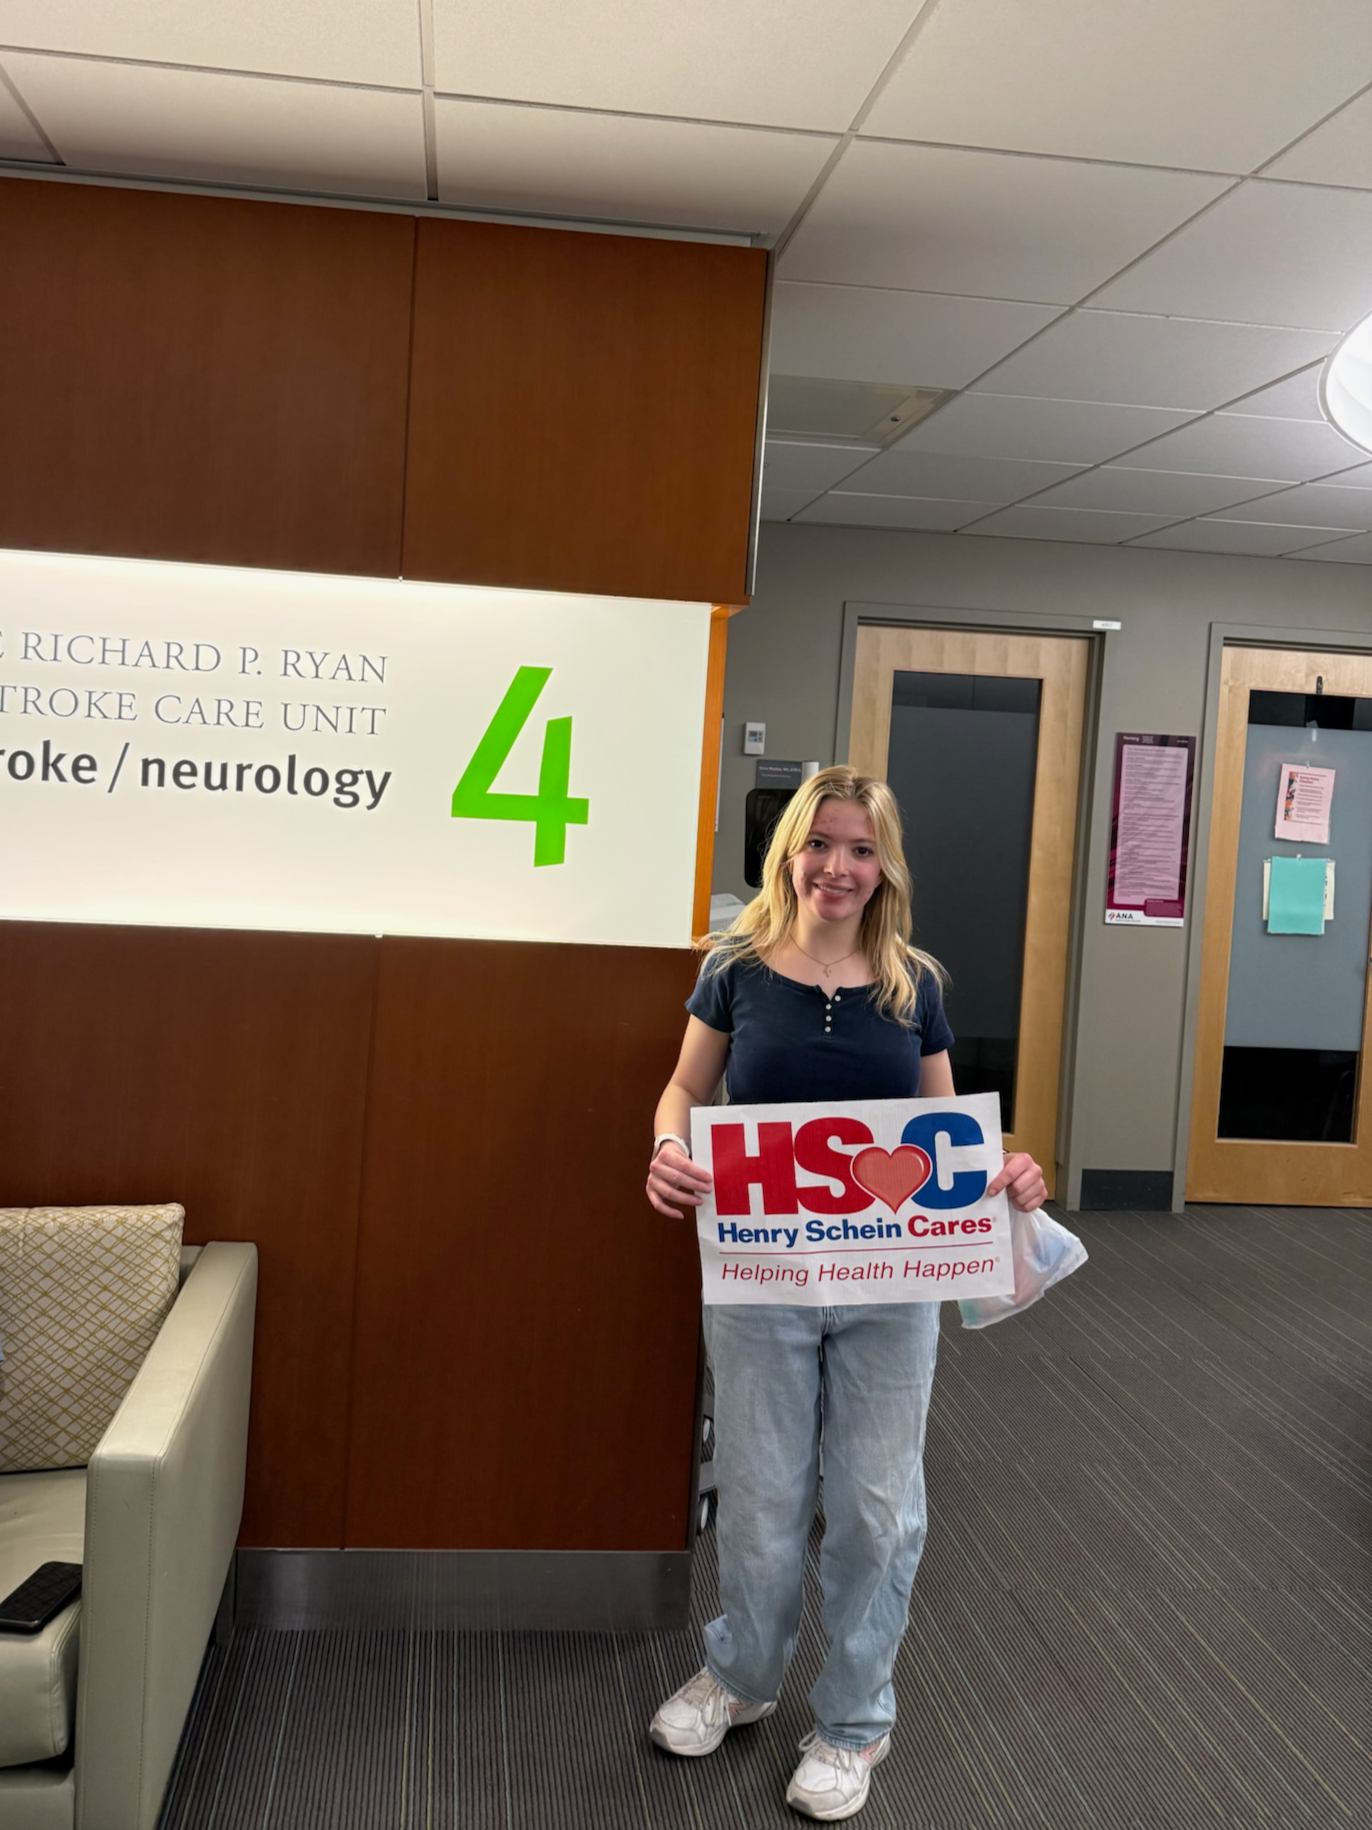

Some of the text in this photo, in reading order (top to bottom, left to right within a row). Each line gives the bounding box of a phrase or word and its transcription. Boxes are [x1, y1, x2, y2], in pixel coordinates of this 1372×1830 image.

[20, 631, 221, 672] RICHARD
[238, 646, 262, 676] P.
[280, 649, 388, 684] RYAN
[155, 694, 264, 729] CARE
[281, 702, 387, 735] UNIT
[141, 753, 392, 811] neurology
[450, 665, 590, 868] 4
[1115, 912, 1134, 920] ANA
[717, 1222, 799, 1248] Henry
[805, 1217, 902, 1242] Schein
[722, 1263, 809, 1287] Helping
[818, 1262, 894, 1283] Health
